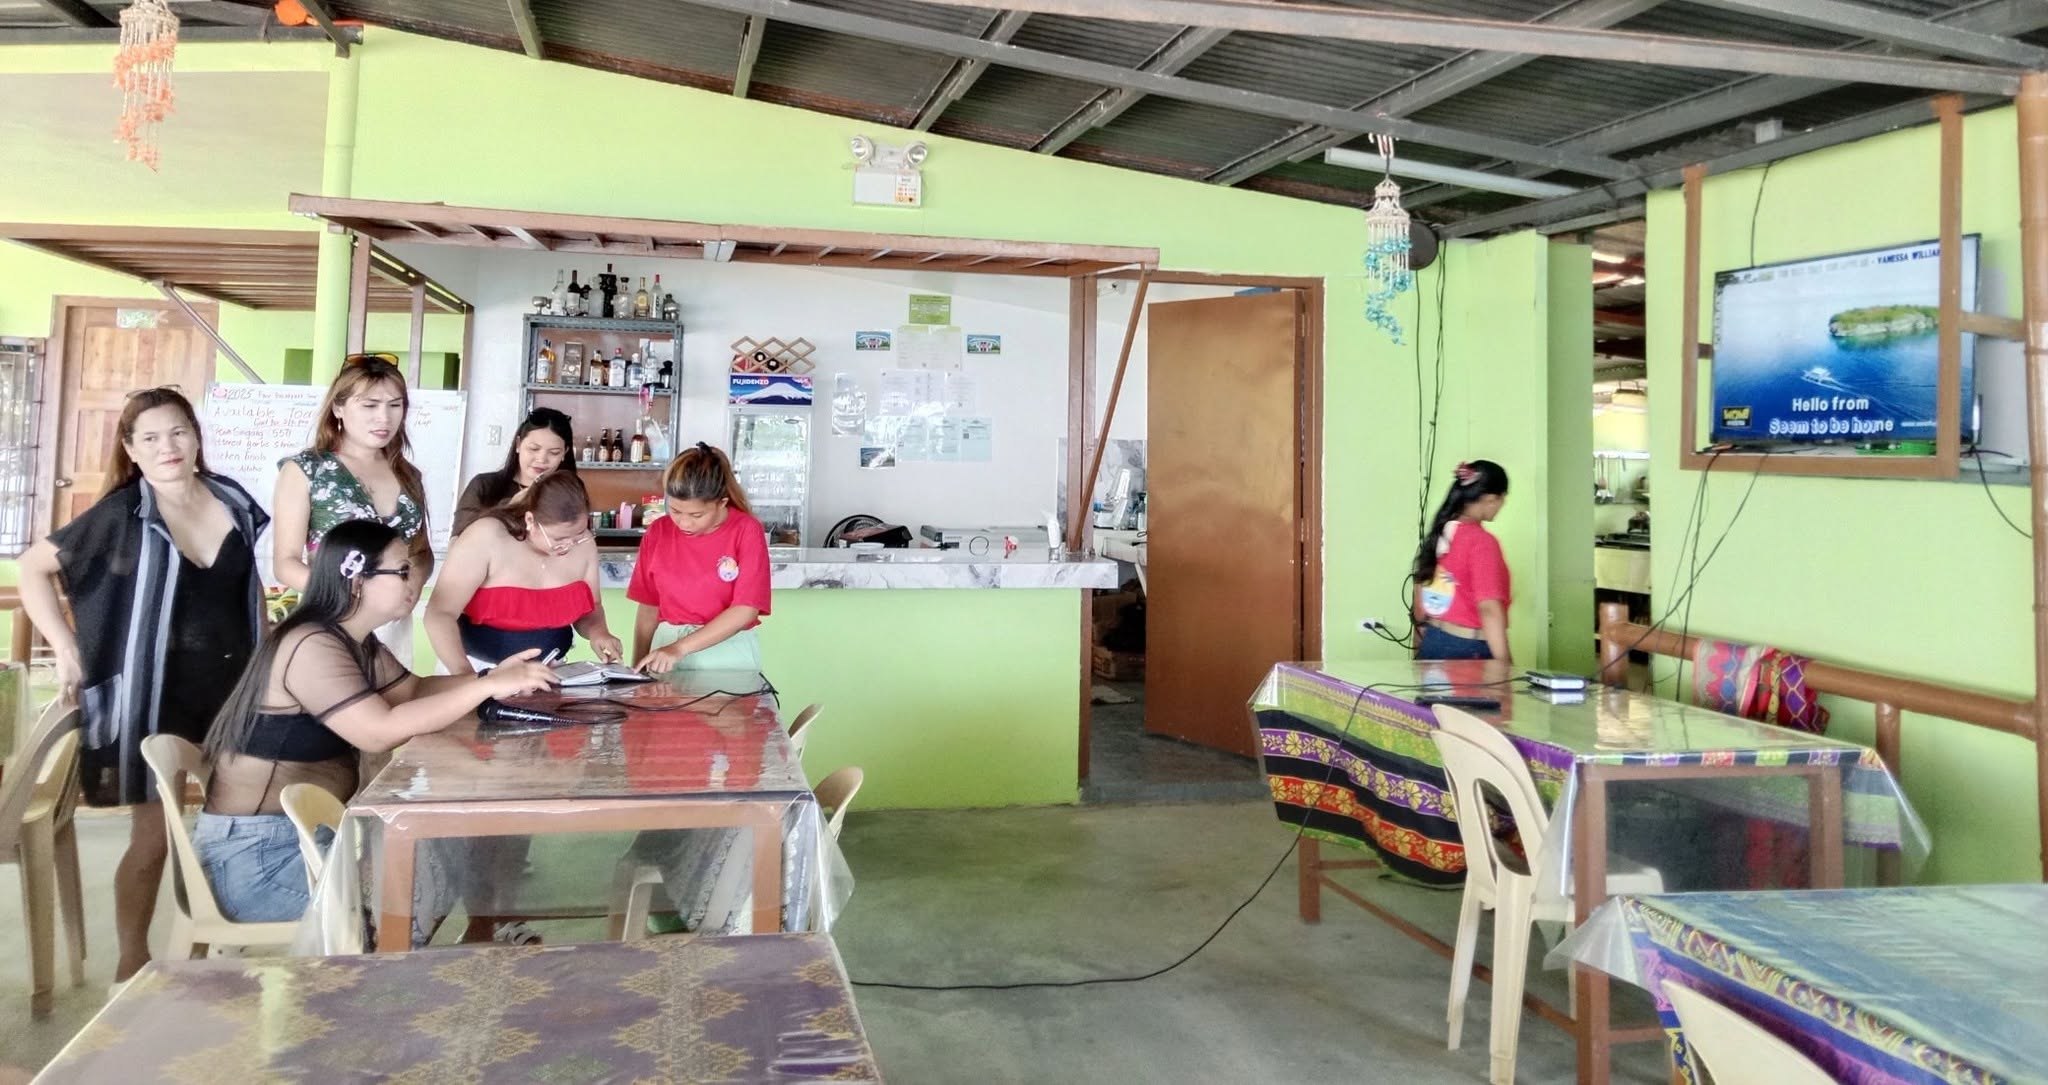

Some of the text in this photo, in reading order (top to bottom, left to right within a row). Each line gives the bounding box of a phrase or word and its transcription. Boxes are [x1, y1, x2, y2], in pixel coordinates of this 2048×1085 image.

[1877, 253, 1909, 264] VANESSA
[732, 378, 769, 386] FUJIDENZO
[1792, 396, 1869, 412] Hello from
[1769, 418, 1809, 434] Seem
[1811, 418, 1827, 434] to
[1829, 417, 1850, 434] be
[1852, 416, 1894, 434] home
